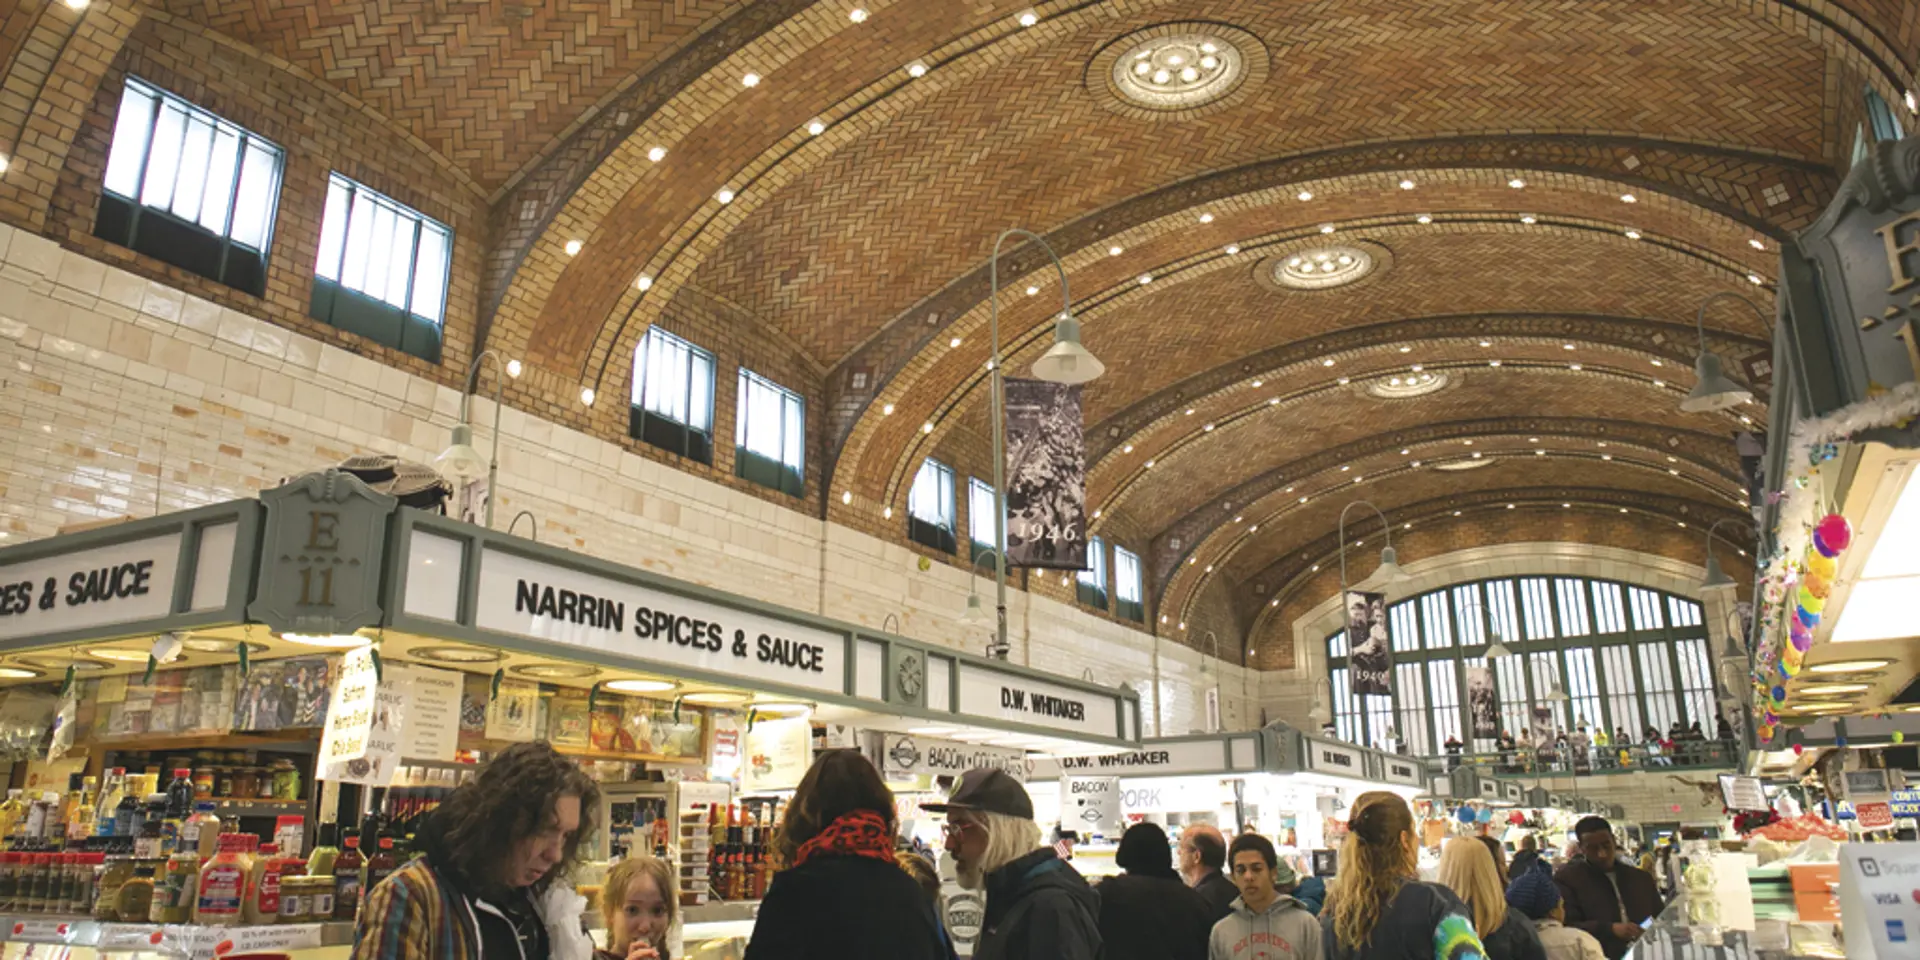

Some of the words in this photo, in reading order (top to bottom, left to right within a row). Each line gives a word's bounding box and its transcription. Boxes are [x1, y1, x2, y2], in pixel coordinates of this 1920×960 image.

[304, 510, 339, 551] E
[1018, 522, 1078, 544] 1946
[38, 577, 57, 611] &
[65, 560, 153, 605] SAUCE
[297, 566, 335, 606] 11
[516, 579, 624, 632] NARRIN
[634, 607, 723, 652] SPICES
[732, 629, 747, 657] &
[756, 634, 824, 672] SAUCE
[376, 693, 403, 706] ARLIC
[1001, 686, 1028, 712] D.W.
[1031, 693, 1085, 721] WHITAKER
[367, 740, 397, 752] ARLIC
[928, 747, 966, 769] BACON
[1063, 757, 1094, 768] D.W.
[1071, 781, 1109, 793] BACON
[1872, 893, 1902, 905] VISA
